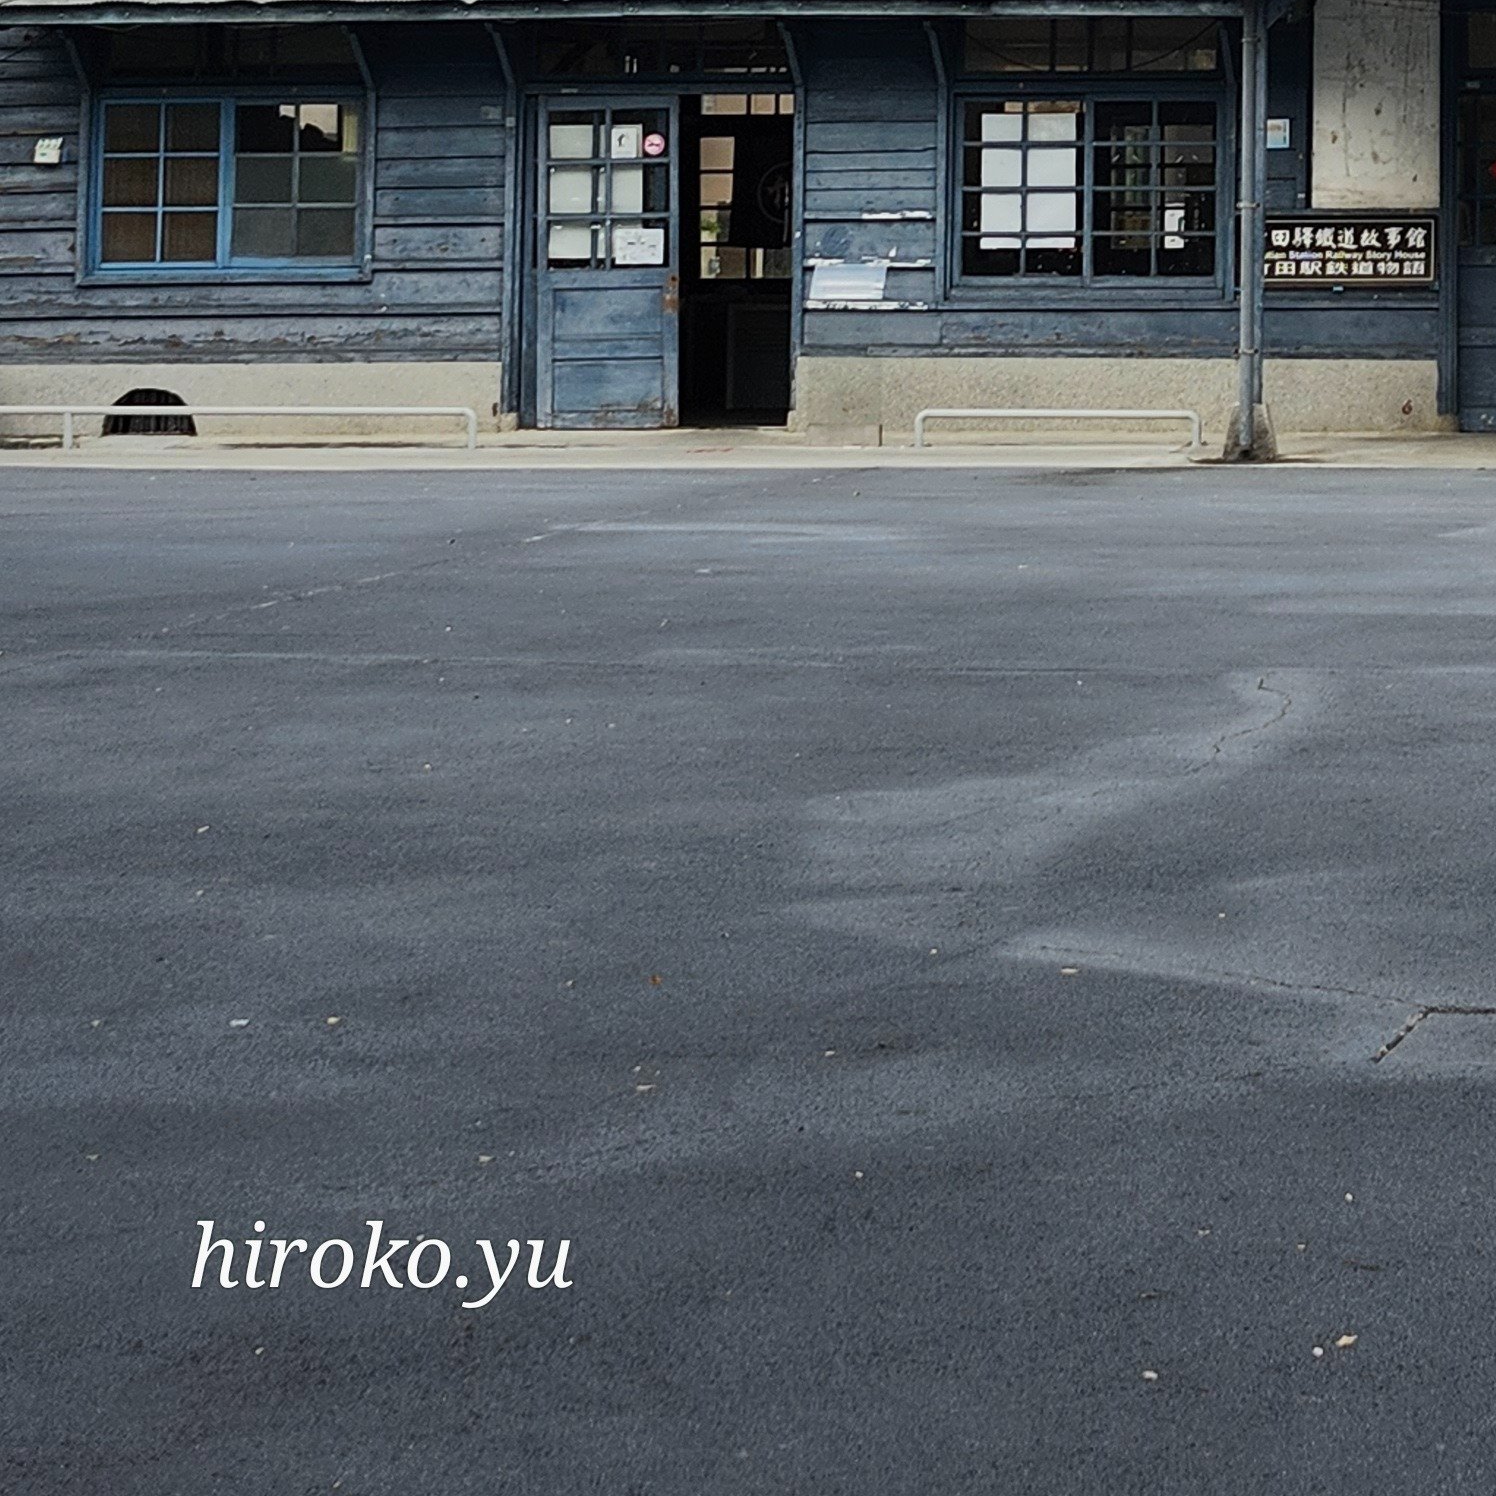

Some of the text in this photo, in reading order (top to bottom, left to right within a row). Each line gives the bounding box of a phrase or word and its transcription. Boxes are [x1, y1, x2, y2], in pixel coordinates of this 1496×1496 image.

[1264, 227, 1427, 250] 田驛鐵道故事館
[1289, 250, 1324, 260] Station
[1325, 250, 1364, 261] Railway
[1365, 250, 1393, 262] Story
[1394, 250, 1427, 260] House
